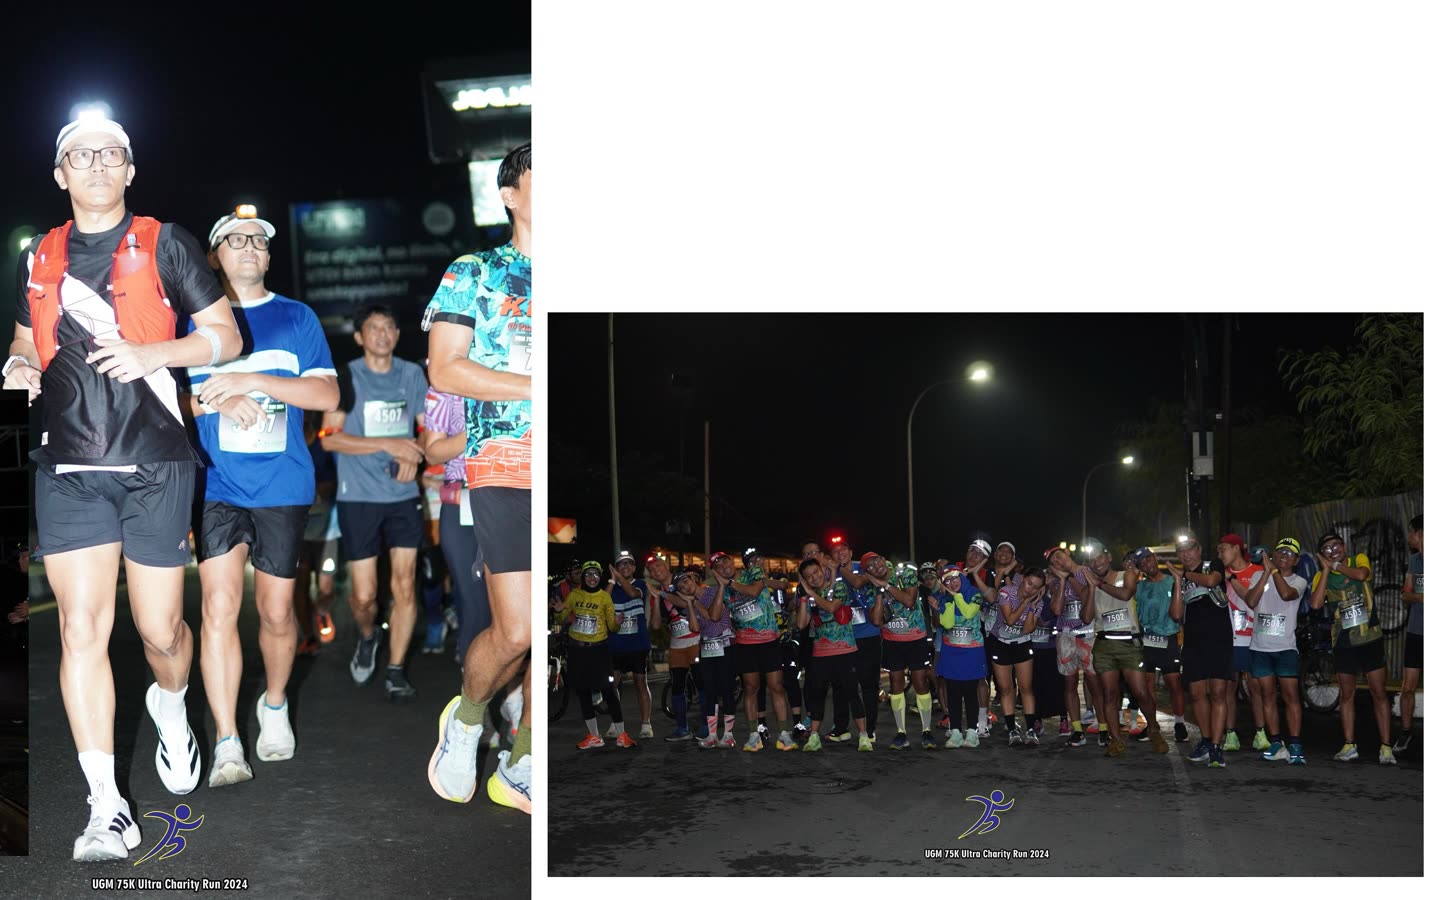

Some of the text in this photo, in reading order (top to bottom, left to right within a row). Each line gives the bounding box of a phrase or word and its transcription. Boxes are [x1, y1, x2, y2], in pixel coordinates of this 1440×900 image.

[374, 408, 402, 423] 4507
[575, 601, 598, 609] KLUB
[740, 604, 756, 616] 7512
[1107, 613, 1125, 623] 7502
[1345, 609, 1362, 620] 4503
[577, 618, 592, 628] 7510
[888, 621, 904, 629] 3003
[952, 630, 968, 638] 1557
[1004, 625, 1021, 635] 7506
[1148, 635, 1165, 643] 1515
